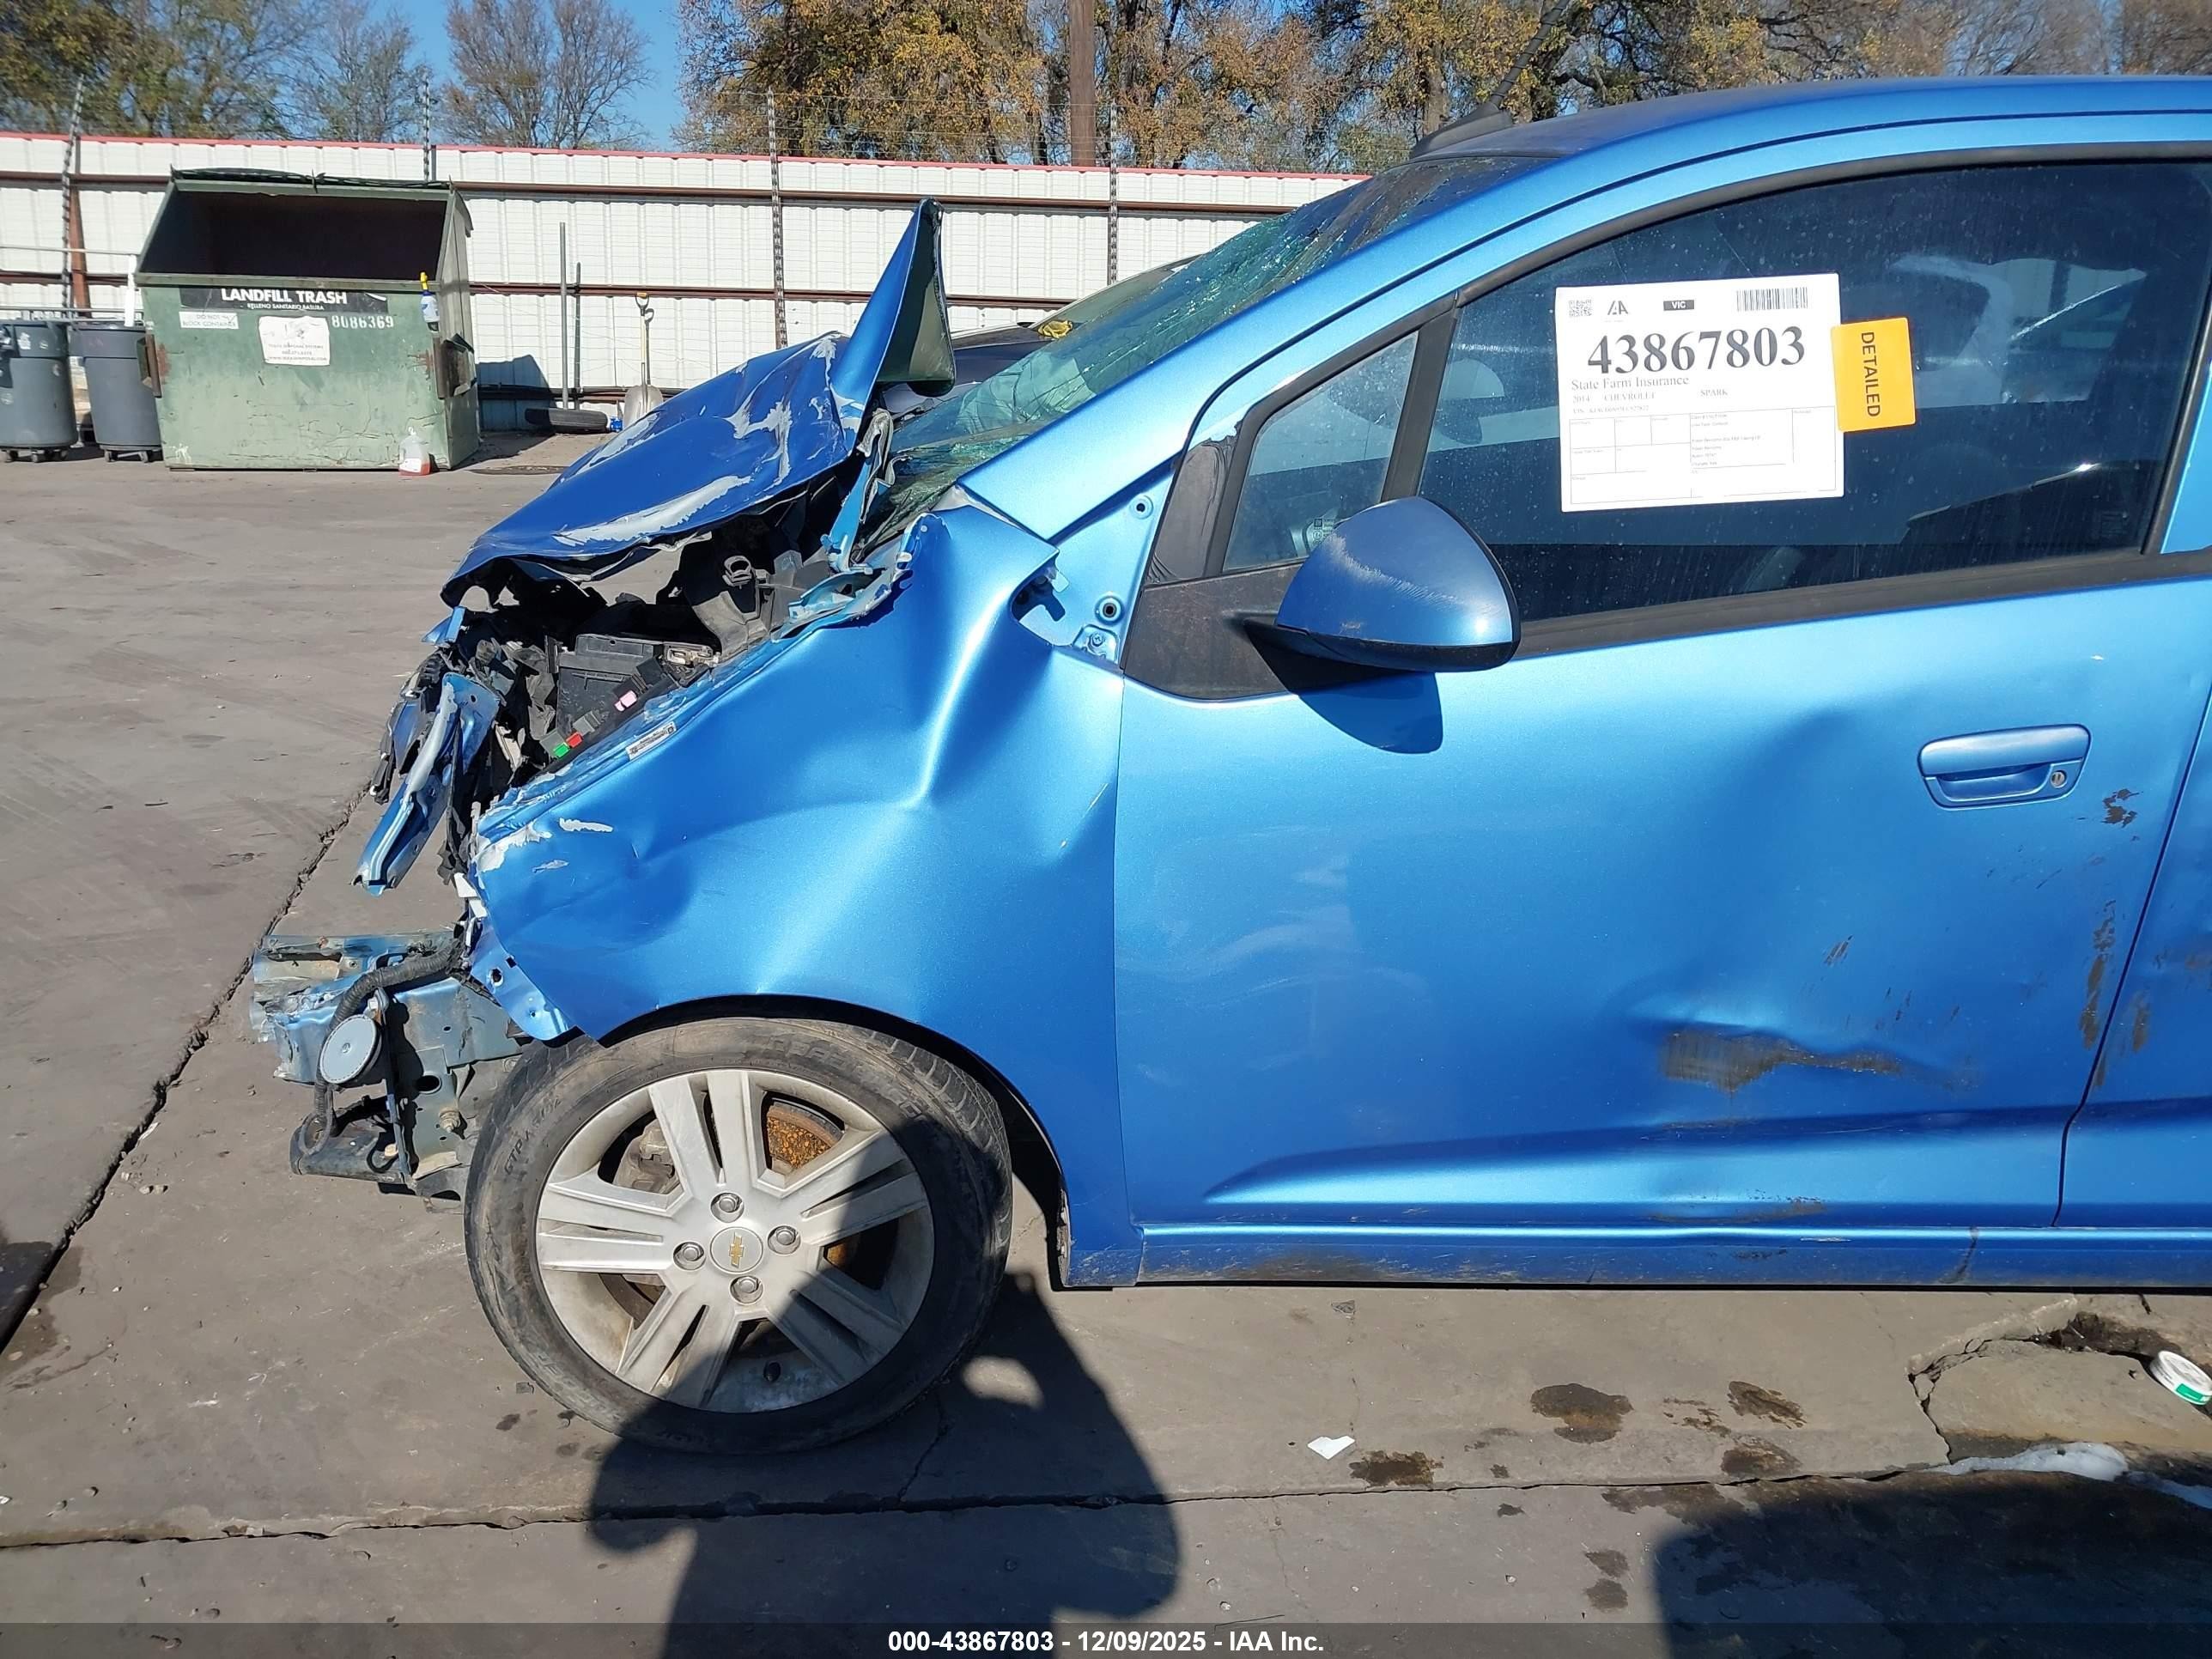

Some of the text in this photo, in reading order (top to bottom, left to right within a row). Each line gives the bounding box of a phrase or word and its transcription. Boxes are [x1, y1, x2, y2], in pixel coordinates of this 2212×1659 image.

[221, 288, 348, 304] LANDFILL TRASH
[1671, 301, 1686, 309] VIC
[331, 315, 394, 329] 8086369
[1587, 325, 1805, 374] 43867803
[1861, 331, 1881, 417] DETAILED
[1571, 376, 1689, 391] State Farm Insurance
[1573, 394, 1590, 404] 2014
